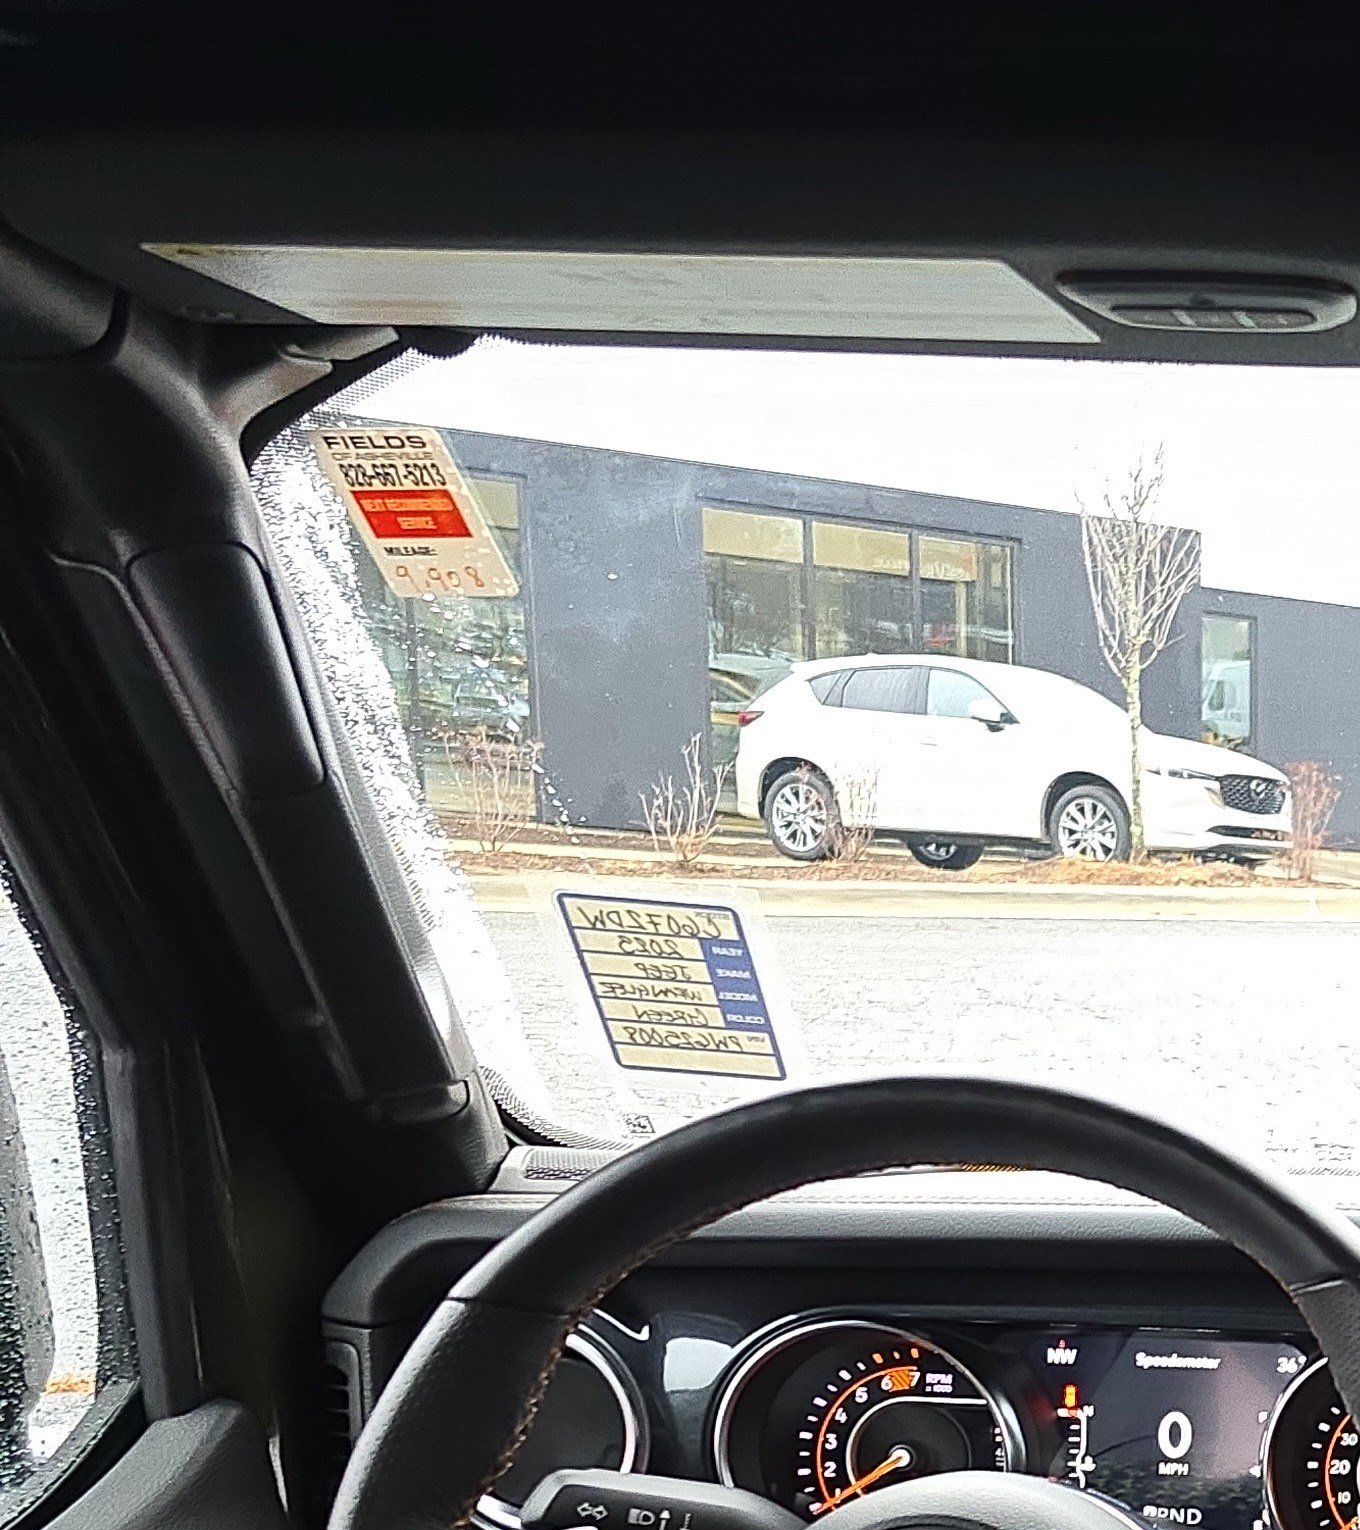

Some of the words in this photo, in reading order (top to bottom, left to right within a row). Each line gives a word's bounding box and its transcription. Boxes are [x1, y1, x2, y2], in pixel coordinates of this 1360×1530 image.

[323, 435, 427, 450] FIELDS
[880, 1374, 893, 1391] 6
[908, 1371, 921, 1387] 7
[855, 1387, 868, 1403] 5
[835, 1407, 848, 1424] 4
[825, 1433, 838, 1449] 3
[1157, 1411, 1193, 1459] 0
[823, 1461, 836, 1478] 2
[1329, 1459, 1351, 1475] 20
[1337, 1490, 1351, 1504] 10
